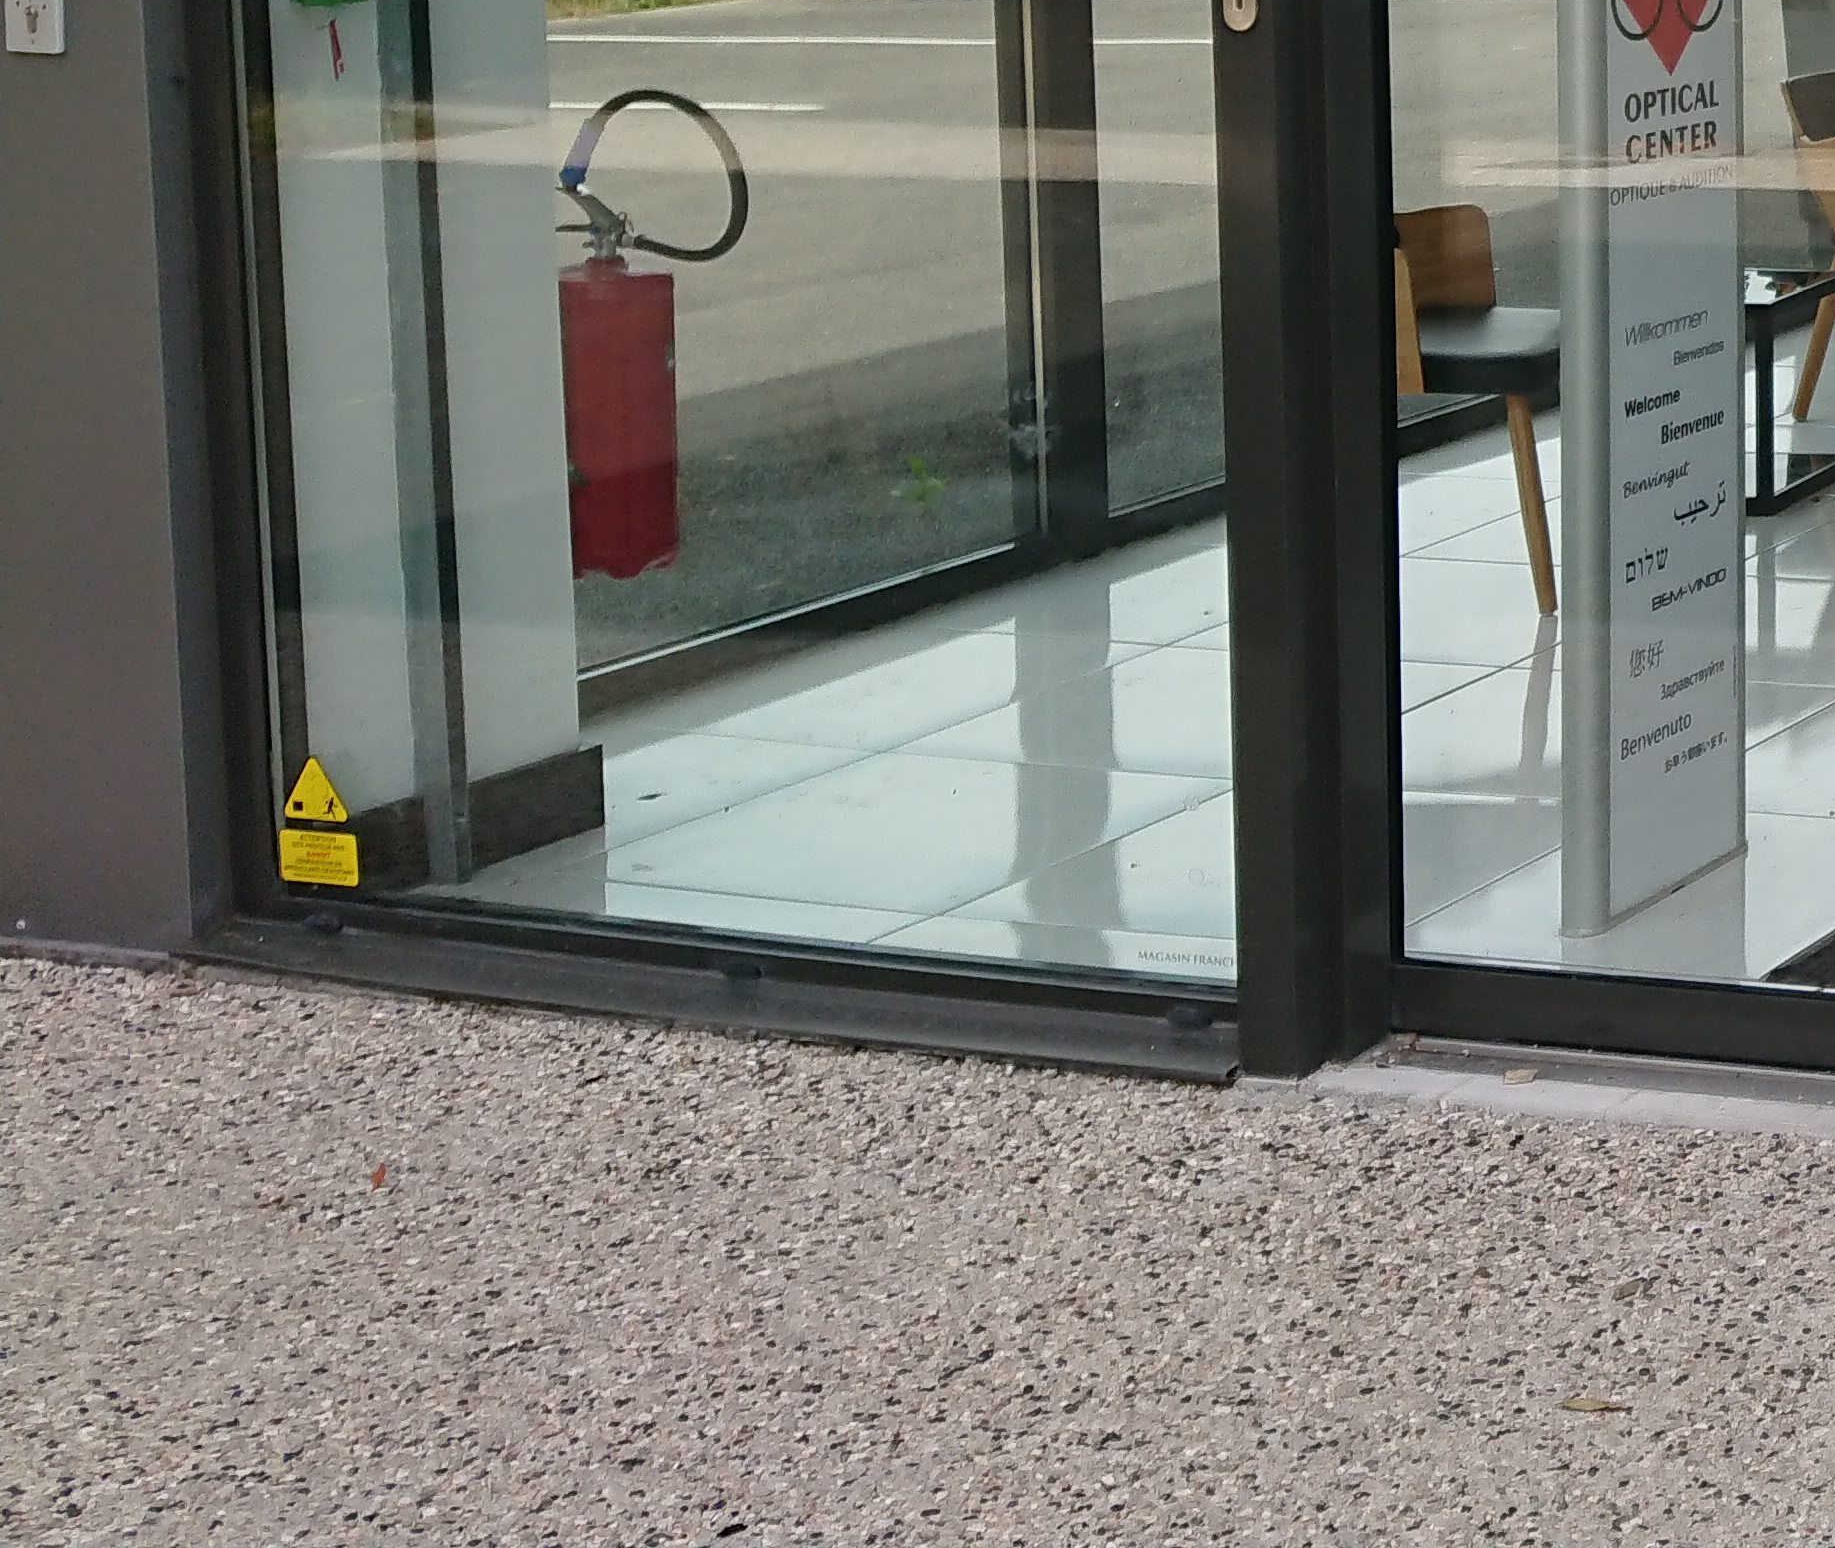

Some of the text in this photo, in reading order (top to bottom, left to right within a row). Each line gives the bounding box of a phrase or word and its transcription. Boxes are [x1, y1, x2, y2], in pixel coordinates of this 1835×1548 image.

[1624, 80, 1719, 123] OPTICAL
[1625, 120, 1717, 164] CENTER
[1610, 180, 1665, 206] OPTIQUE
[1678, 165, 1733, 191] AUDITION
[1625, 309, 1709, 347] Willkommen
[1673, 339, 1725, 366] Bienvenidos
[1624, 389, 1681, 419] Welcome
[1661, 409, 1725, 445] Bienvenue
[1622, 460, 1691, 499] Benvingut
[1625, 547, 1669, 584] שלום
[1651, 567, 1727, 612] BEM-VINDO
[1660, 658, 1725, 701] Здравствуйте
[1620, 712, 1692, 761] Benvenuto
[1138, 949, 1190, 963] MAGASIN
